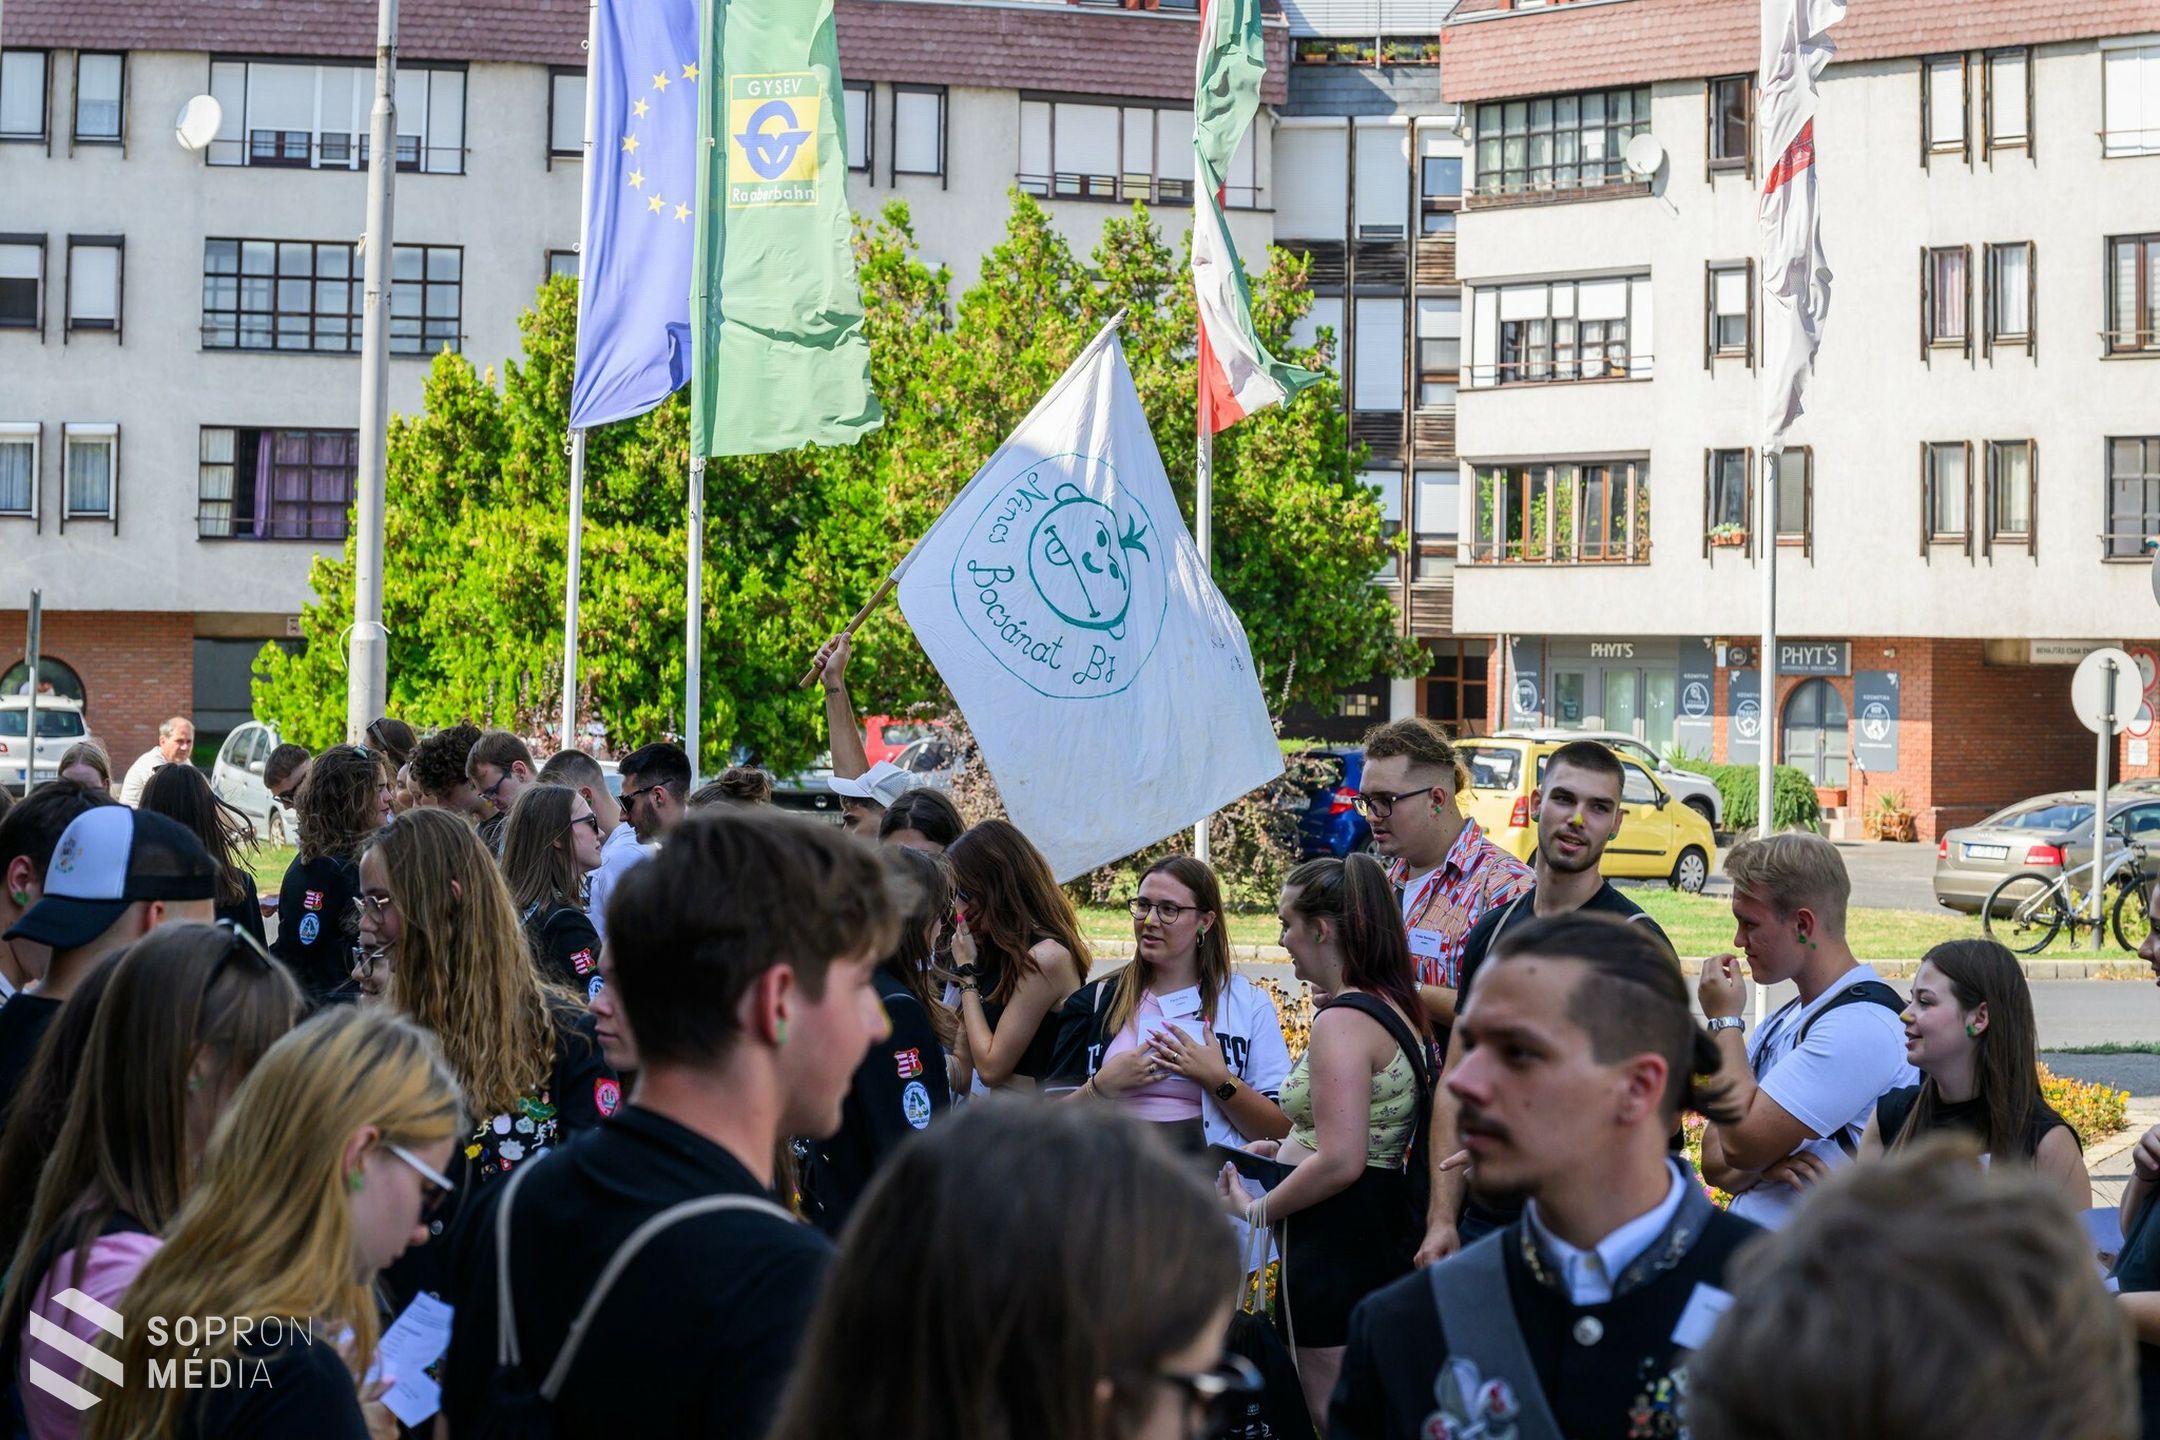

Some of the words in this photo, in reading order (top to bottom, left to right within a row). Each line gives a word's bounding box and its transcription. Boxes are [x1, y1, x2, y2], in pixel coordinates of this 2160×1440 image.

[747, 79, 802, 96] GYSEV
[732, 186, 815, 203] Raaberbahn
[967, 559, 1063, 670] Bocsánat
[1591, 642, 1634, 658] PHYT'S
[1781, 644, 1838, 666] PHYT'S
